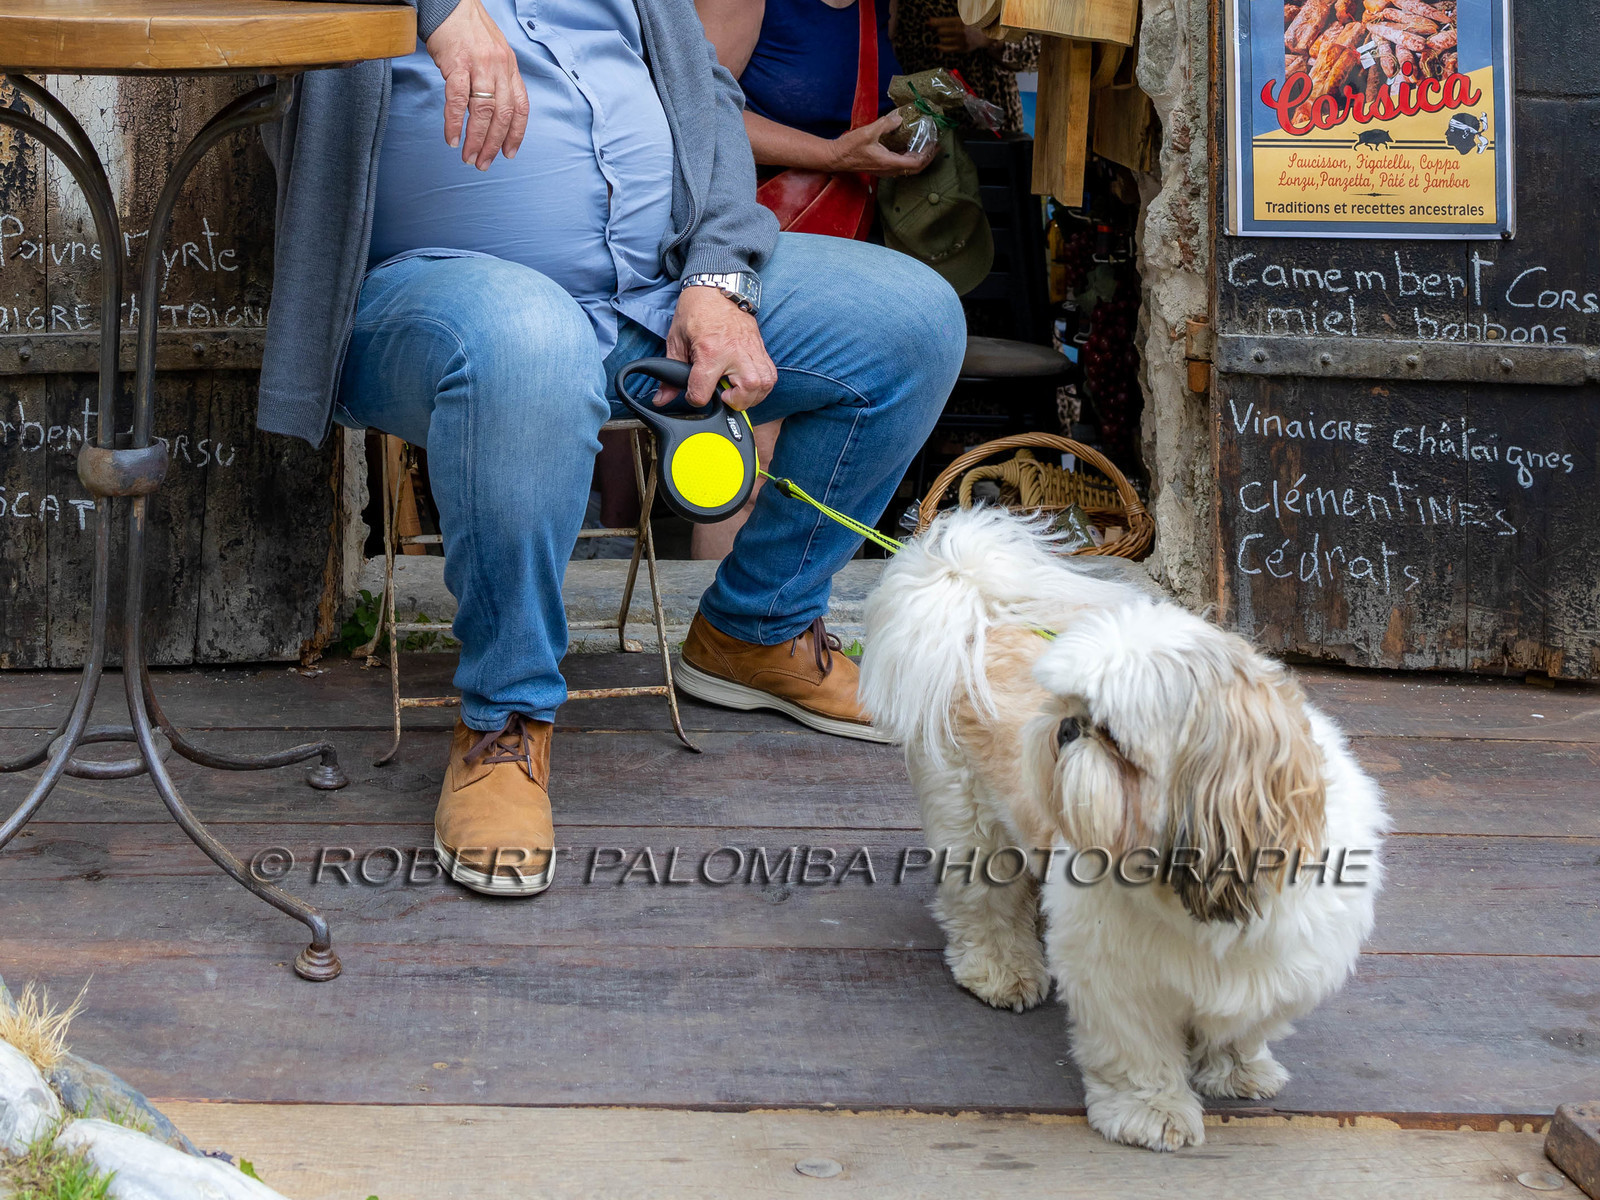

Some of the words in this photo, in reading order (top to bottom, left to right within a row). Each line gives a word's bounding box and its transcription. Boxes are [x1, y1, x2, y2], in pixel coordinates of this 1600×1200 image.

[1261, 60, 1482, 136] Corsica
[1288, 153, 1351, 172] Saucisson,
[1356, 154, 1415, 174] Figatellu,
[1419, 154, 1461, 173] Coppa
[1379, 172, 1406, 188] Pâté
[1408, 176, 1420, 188] et
[1423, 173, 1471, 194] Jambon
[1265, 201, 1330, 215] Traditions
[1334, 203, 1347, 215] et
[1351, 203, 1406, 216] recettes
[1409, 204, 1485, 217] ancestrales
[1268, 296, 1358, 337] miel
[1413, 305, 1567, 344] bonbons
[726, 415, 742, 439] flexi
